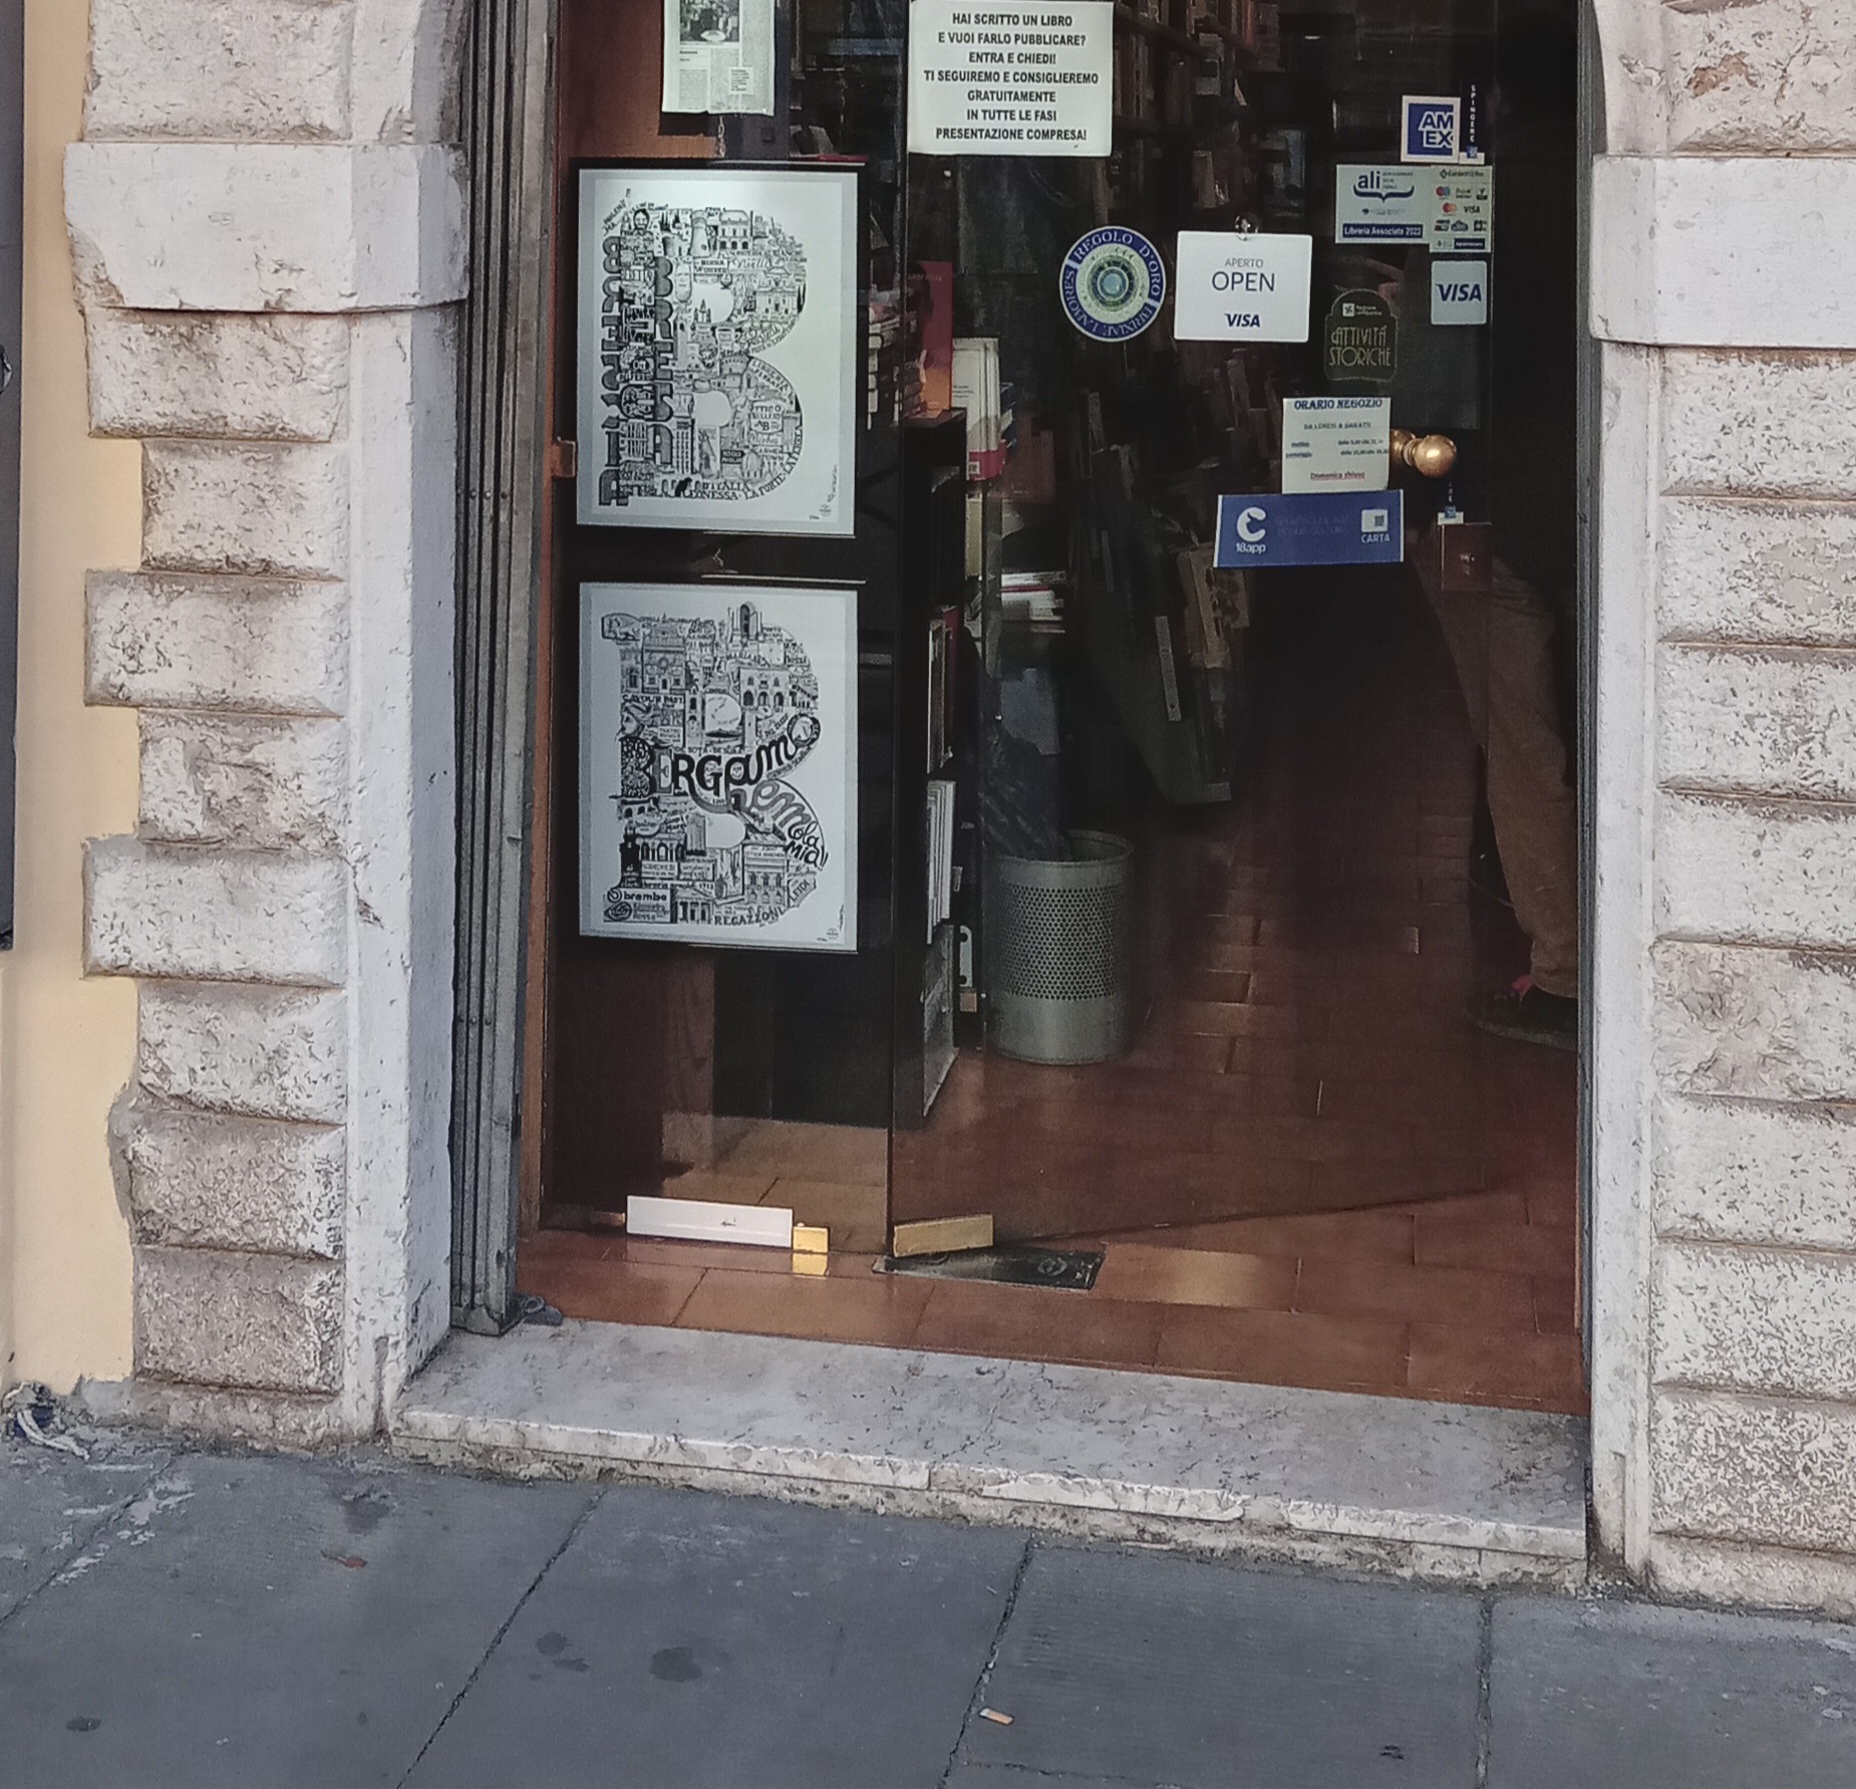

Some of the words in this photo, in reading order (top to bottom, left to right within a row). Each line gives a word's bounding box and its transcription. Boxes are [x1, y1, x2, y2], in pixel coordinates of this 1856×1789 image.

[952, 13, 972, 25] HAI
[974, 13, 1020, 26] SCRITTO
[1022, 14, 1038, 26] UN
[1040, 15, 1073, 27] LIBRO
[938, 32, 945, 44] E
[947, 32, 975, 44] VUOI
[977, 32, 1012, 45] FARLO
[1014, 33, 1086, 46] PUBBLICARE?
[968, 52, 1005, 64] ENTRA
[1007, 52, 1015, 64] E
[1017, 52, 1056, 65] CHIEDI!
[924, 70, 935, 82] TI
[937, 70, 1000, 83] SEGUIREMO
[1003, 70, 1011, 83] E
[1012, 71, 1099, 84] CONSIGLIEREMO
[967, 89, 1056, 102] GRATUITAMENTE
[966, 109, 979, 121] IN
[981, 109, 1017, 121] TUTTE
[1018, 110, 1033, 122] LE
[1034, 110, 1057, 122] FASI
[1420, 111, 1454, 131] AM
[936, 127, 1025, 140] PRESENTAZIONE
[1026, 128, 1087, 141] COMPRESA!
[1424, 129, 1453, 147] EX
[1357, 170, 1381, 189] ali
[1344, 225, 1371, 236] Libreria
[1072, 230, 1134, 260] REGOLO
[1224, 257, 1264, 269] APERTO
[1211, 271, 1275, 292] OPEN
[1435, 283, 1483, 303] VISA
[1224, 313, 1261, 328] VISA
[1328, 346, 1391, 367] STORICHE
[1293, 399, 1336, 411] ORARIO
[1336, 398, 1383, 409] NEGOZIO
[1360, 533, 1391, 544] CARTA
[1235, 542, 1266, 555] 18app
[623, 891, 668, 902] brembo
